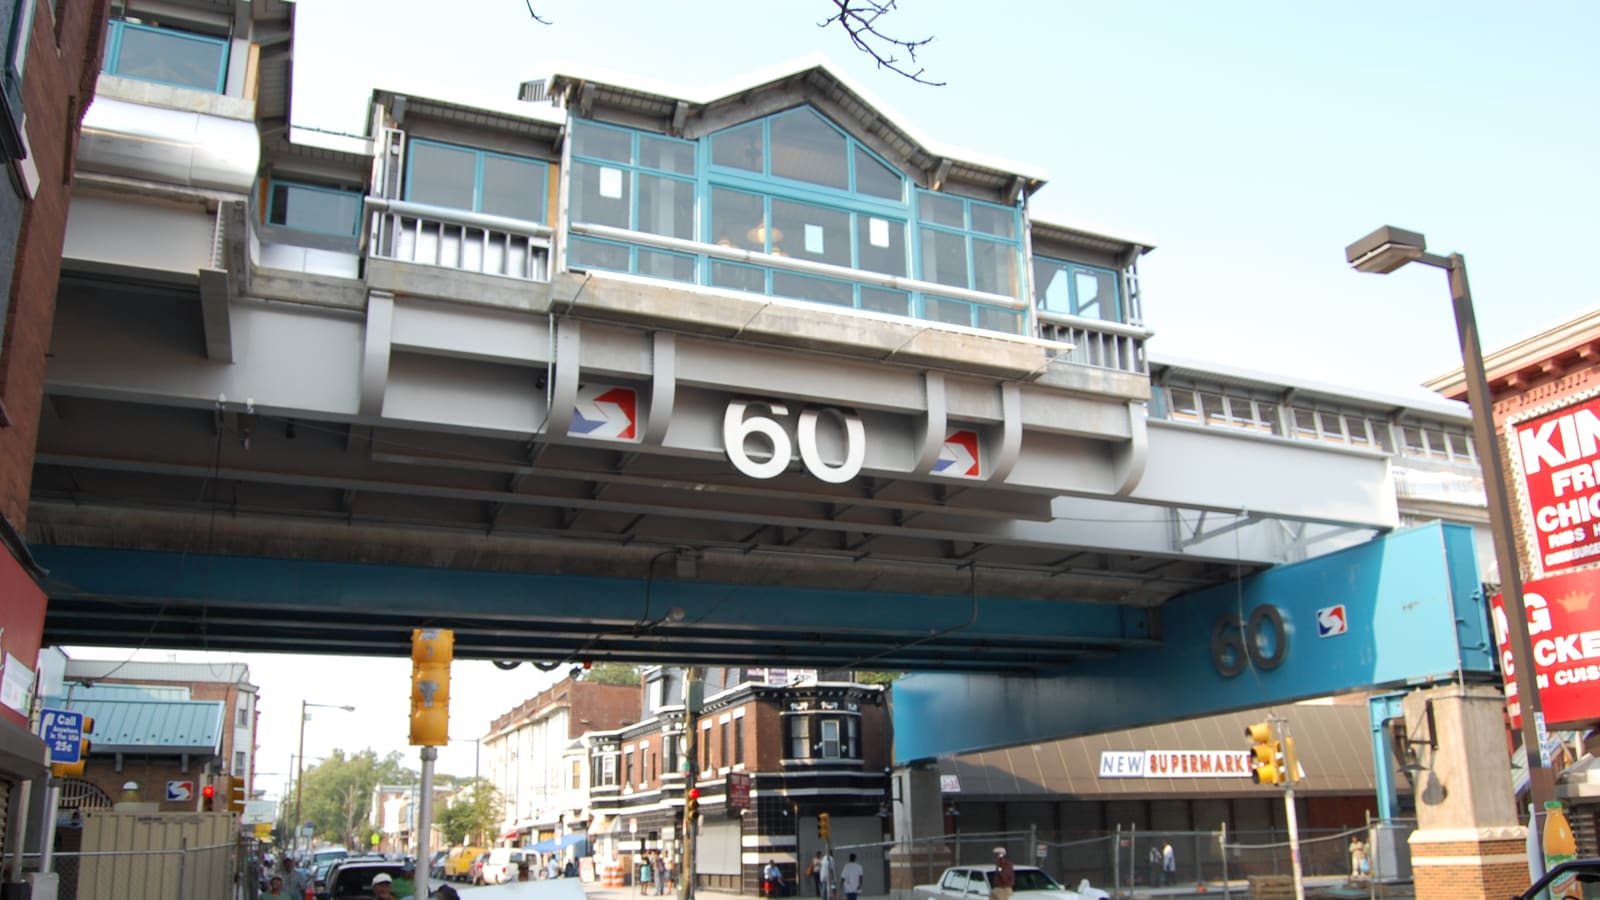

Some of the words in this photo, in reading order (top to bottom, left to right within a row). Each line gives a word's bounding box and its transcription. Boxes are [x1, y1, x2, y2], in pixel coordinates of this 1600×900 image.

[724, 399, 866, 484] 60
[1210, 603, 1286, 678] 60
[57, 714, 77, 726] Call
[1102, 755, 1142, 774] NEW
